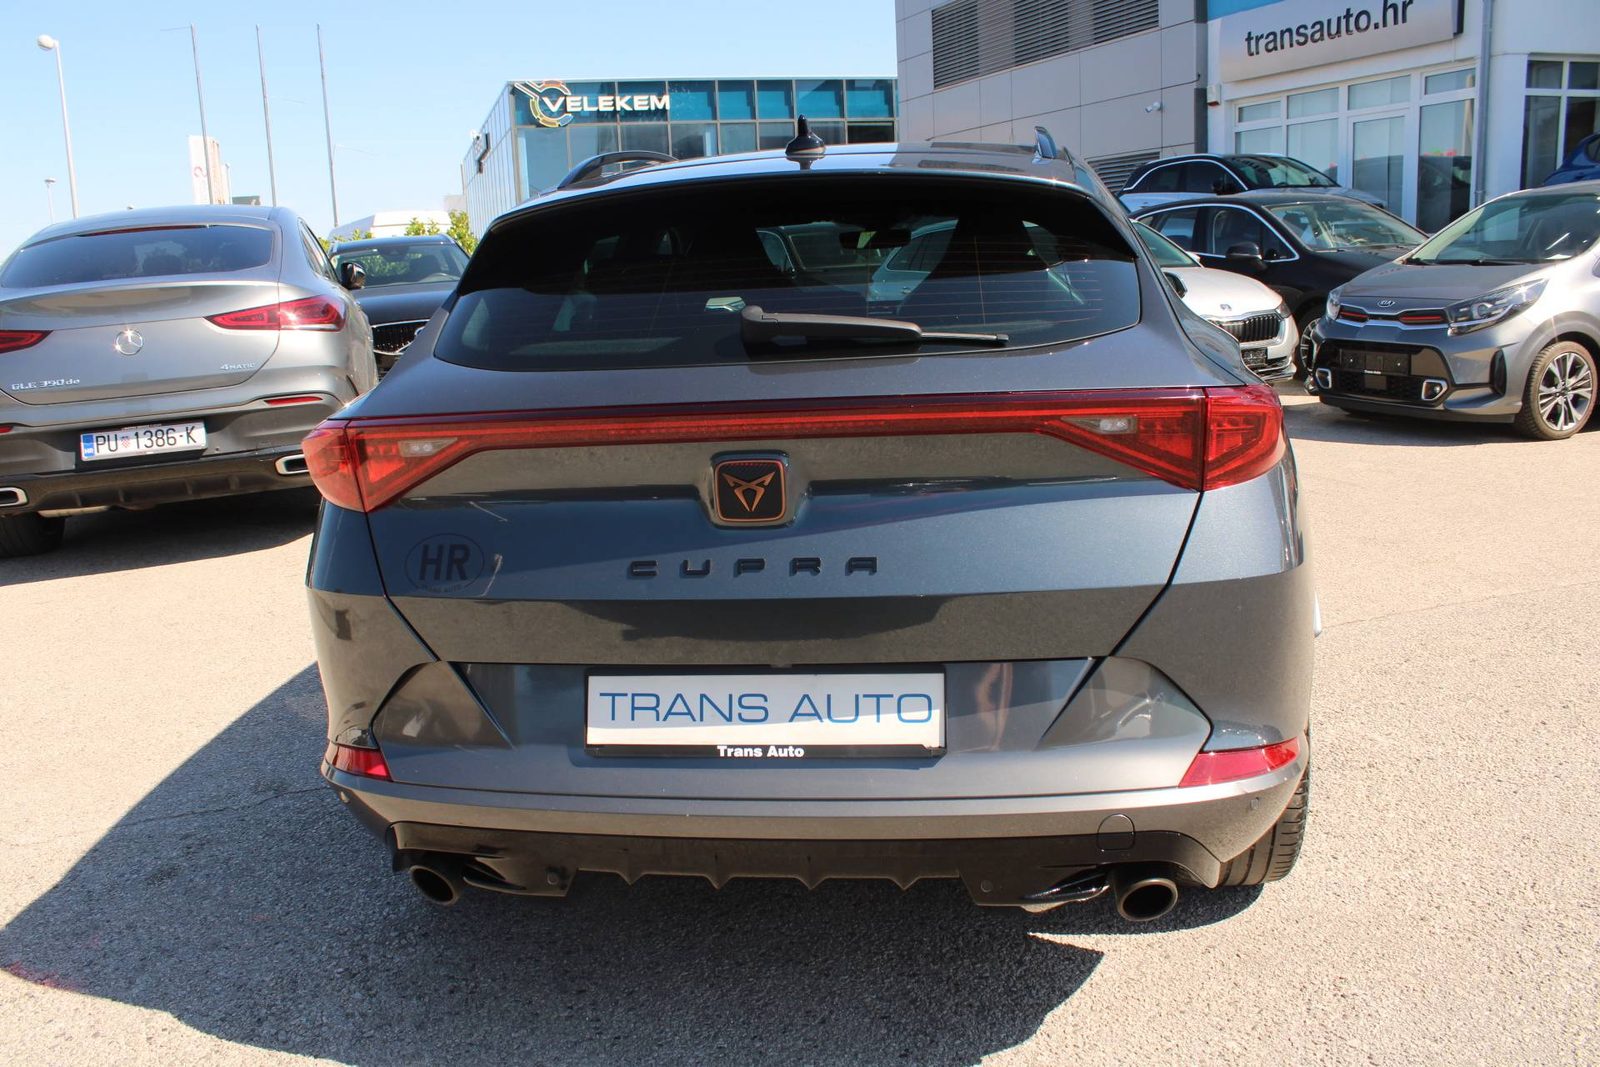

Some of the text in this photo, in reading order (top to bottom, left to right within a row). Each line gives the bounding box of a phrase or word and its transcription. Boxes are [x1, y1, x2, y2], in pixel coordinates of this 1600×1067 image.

[1245, 0, 1414, 56] transauto.hr
[543, 95, 670, 112] VELEKEM
[95, 434, 118, 453] PU
[419, 543, 470, 580] HR
[627, 556, 877, 576] CUPRA
[599, 692, 932, 723] TRANS AUTO
[716, 745, 805, 758] Trans Auto
